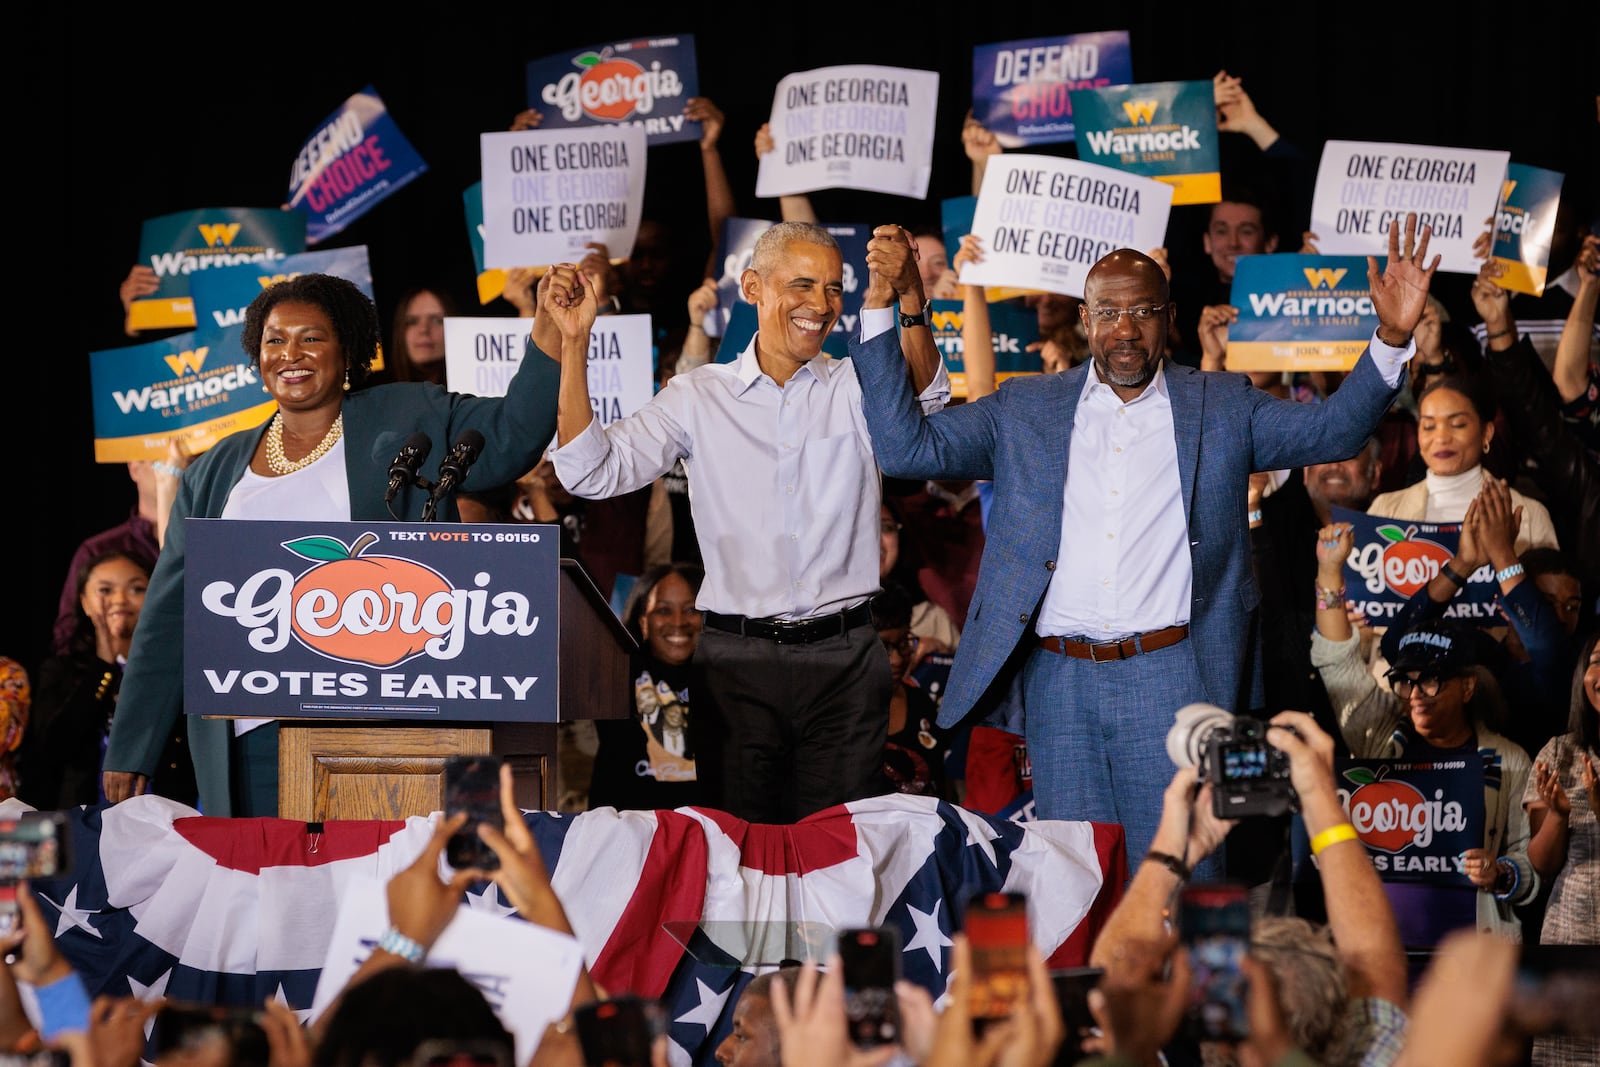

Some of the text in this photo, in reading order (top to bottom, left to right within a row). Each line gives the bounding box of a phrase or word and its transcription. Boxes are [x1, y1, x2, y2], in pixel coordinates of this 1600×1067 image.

[993, 44, 1100, 86] DEFEND
[541, 60, 684, 122] Georgia
[787, 78, 910, 110] ONE GEORGIA
[1012, 78, 1110, 120] CHOI
[785, 105, 907, 137] ONE GEORGIA
[289, 110, 364, 192] DEFEND
[785, 132, 905, 167] ONE GEORGIA
[1085, 125, 1201, 155] Warnock
[306, 134, 392, 213] CHOICE
[511, 140, 630, 174] ONE GEORGIA
[1347, 154, 1476, 185] ONE GEORGIA
[511, 172, 631, 205] ONE GEORGIA
[1006, 168, 1141, 215] ONE GEORGIA
[1340, 180, 1470, 212] ONE GEORGIA
[513, 205, 554, 235] ONE
[559, 202, 627, 233] GEORGIA
[999, 197, 1136, 245] ONE GEORGIA
[1336, 208, 1375, 235] ONE
[993, 226, 1128, 265] ONE GEORG
[1249, 293, 1377, 317] Warnoc
[1291, 316, 1360, 327] U.S. SENATE
[475, 332, 518, 362] ONE
[1296, 346, 1320, 357] JOIN
[111, 363, 258, 415] Warnock
[161, 392, 230, 418] U.S. SENATE
[388, 531, 541, 544] TEXT VOTE TO 60150
[201, 568, 541, 661] Georgia
[1441, 602, 1498, 619] ARLY
[202, 668, 539, 701] VOTES EARLY
[1433, 762, 1443, 770] TO
[1443, 761, 1466, 770] 60150
